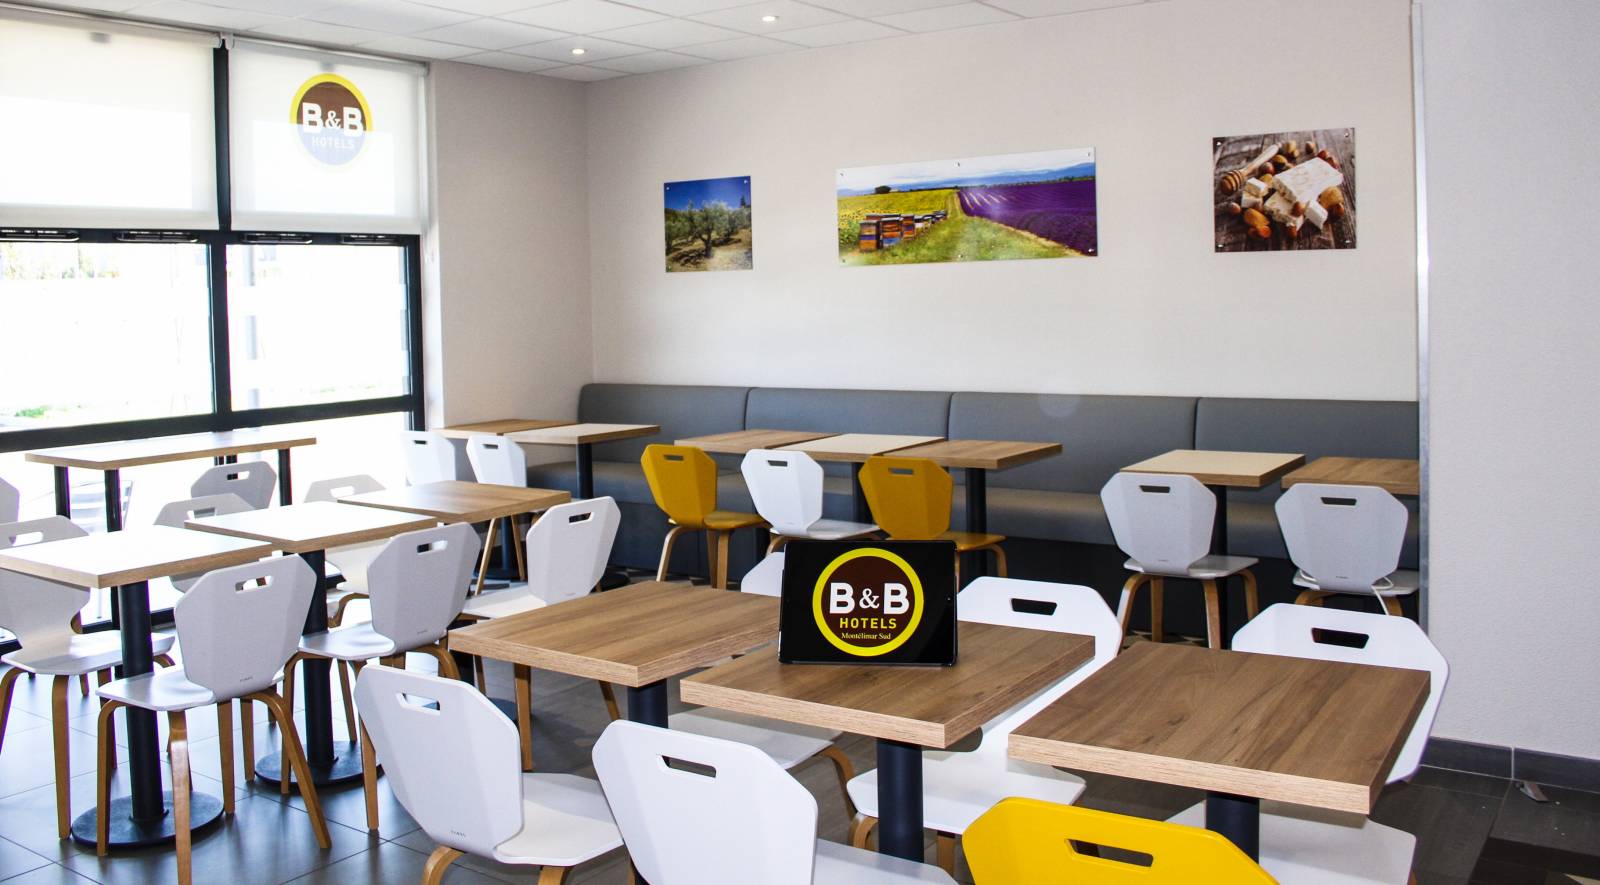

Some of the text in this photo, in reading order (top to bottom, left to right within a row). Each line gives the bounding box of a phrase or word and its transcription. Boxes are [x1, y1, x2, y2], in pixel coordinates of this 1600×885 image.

[302, 102, 364, 137] B&B
[311, 135, 354, 149] HOTELS
[829, 582, 910, 615] B&B
[839, 617, 897, 629] HOTELS
[841, 632, 891, 640] Montélimar Sud
